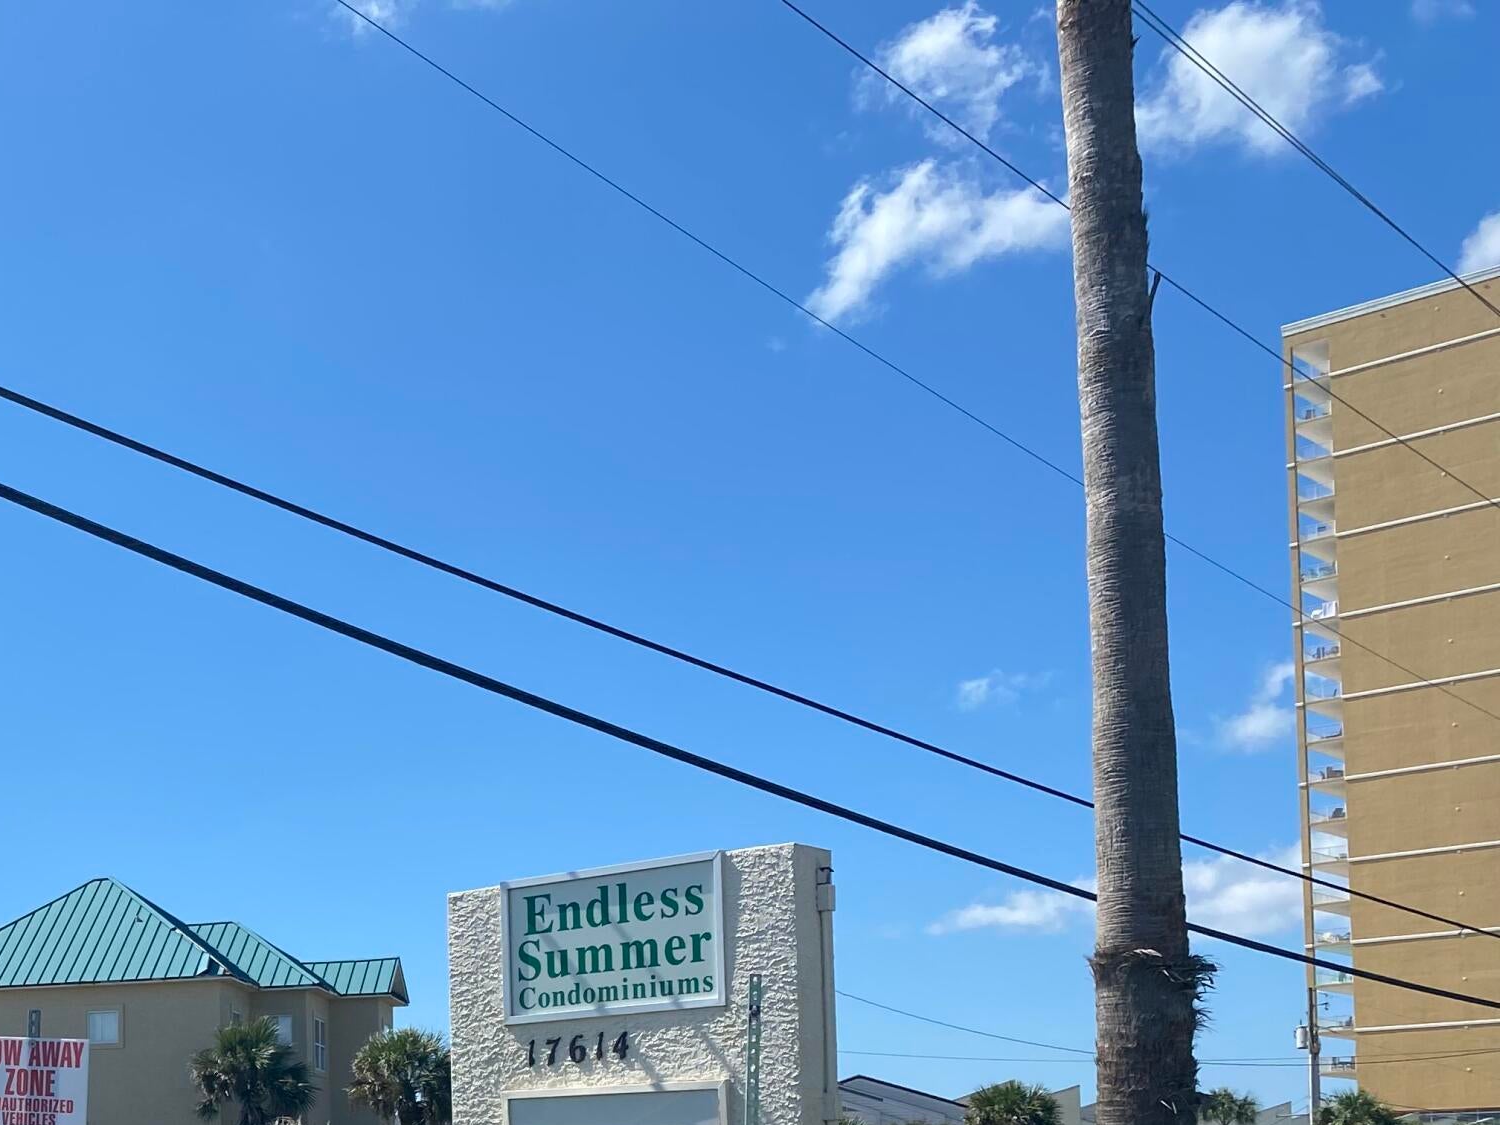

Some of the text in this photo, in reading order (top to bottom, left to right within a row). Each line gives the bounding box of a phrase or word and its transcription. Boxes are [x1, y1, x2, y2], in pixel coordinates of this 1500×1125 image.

[523, 882, 704, 936] Endless
[518, 932, 712, 982] Summer
[519, 974, 714, 1010] Condominiums
[28, 1041, 84, 1069] AWAY
[528, 1031, 629, 1067] 17614
[4, 1069, 55, 1097] ZONE
